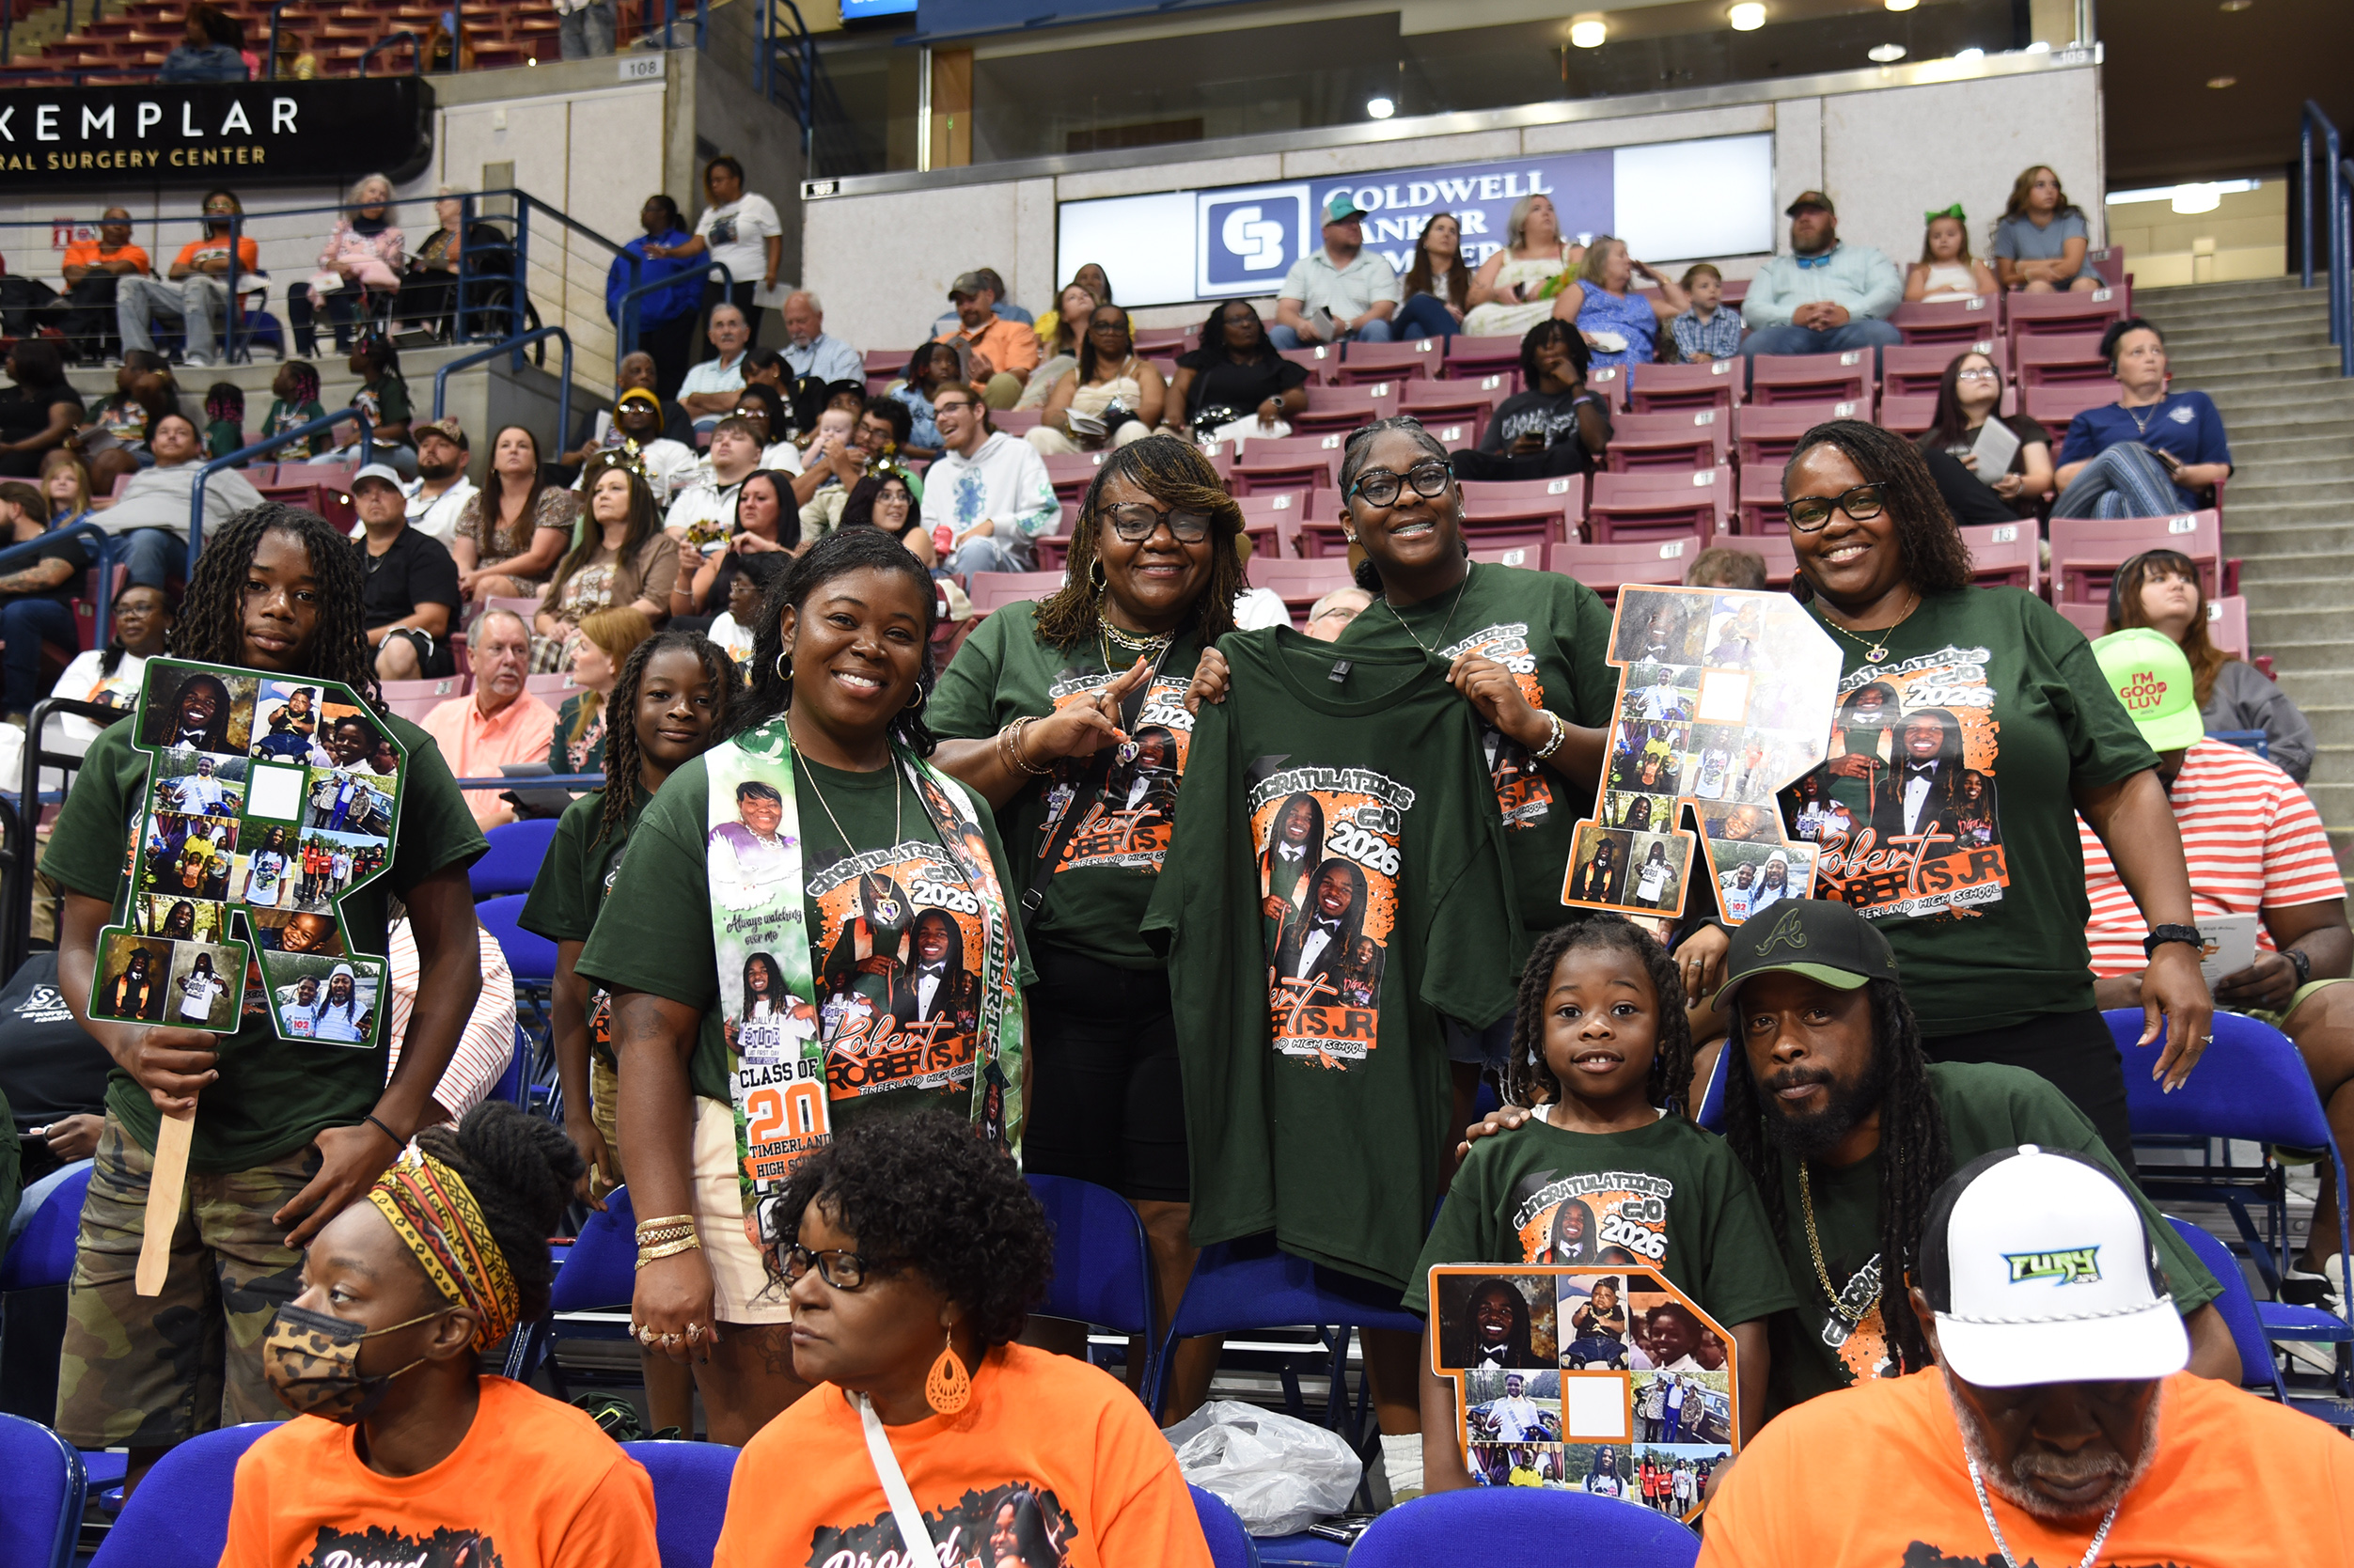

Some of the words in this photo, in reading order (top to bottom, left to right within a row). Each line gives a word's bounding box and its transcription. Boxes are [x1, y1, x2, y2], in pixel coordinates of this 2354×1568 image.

[630, 61, 657, 76] 108
[46, 149, 160, 170] SURGERY
[169, 146, 265, 166] CENTER
[1999, 528, 2012, 541] 13
[2131, 671, 2154, 685] I'M
[1905, 685, 1995, 708] 2026
[2128, 694, 2162, 711] LUV
[1128, 852, 1153, 864] HIGH
[1326, 822, 1403, 876] 2026
[1956, 849, 2006, 886] JR
[911, 879, 981, 915] 2026
[1733, 902, 1747, 911] 102
[1919, 893, 1951, 909] HIGH
[1952, 884, 2001, 903] SCHOOL
[763, 906, 802, 924] watching
[745, 933, 763, 946] over
[294, 1020, 309, 1029] 102
[1332, 1010, 1376, 1040] JR
[821, 1010, 955, 1070] Robert
[1291, 1039, 1323, 1050] HIGH
[1324, 1040, 1368, 1054] SCHOOL
[739, 1062, 793, 1089] CLASS
[798, 1058, 819, 1080] OF
[859, 1075, 924, 1096] TIMBERLAND
[926, 1069, 949, 1083] HIGH
[746, 1081, 829, 1141] 20
[749, 1133, 833, 1159] TIMBERLAND
[756, 1160, 786, 1178] HIGH
[1600, 1214, 1669, 1260] 2026
